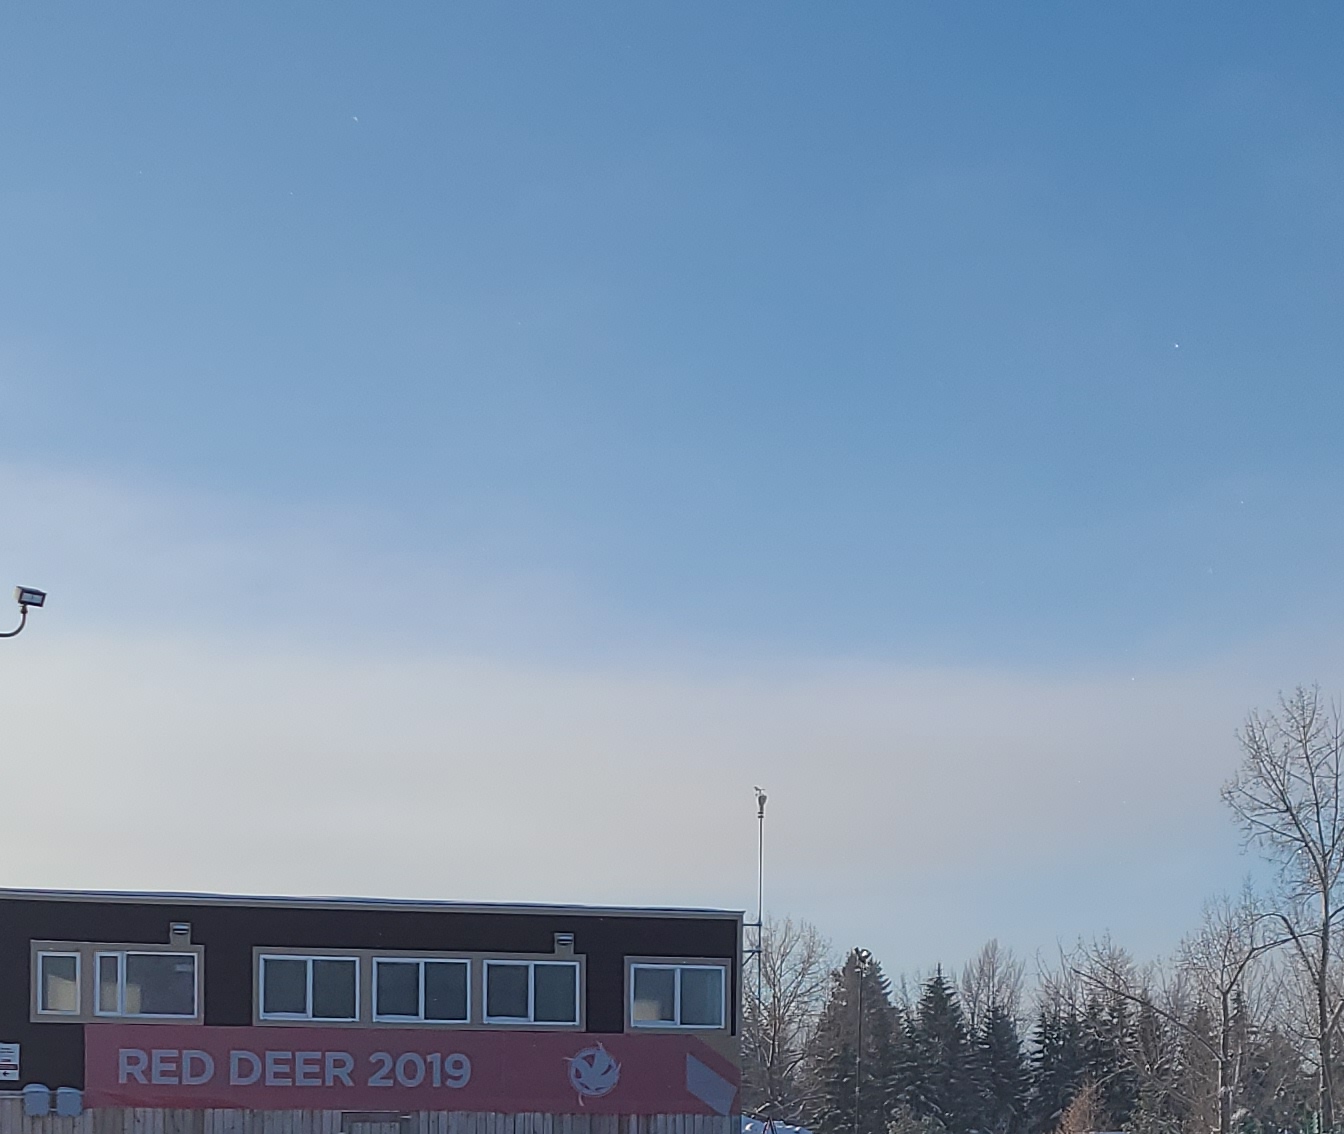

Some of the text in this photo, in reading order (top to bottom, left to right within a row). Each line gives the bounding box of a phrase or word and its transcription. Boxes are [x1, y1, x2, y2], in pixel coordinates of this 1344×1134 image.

[118, 1048, 472, 1089] RED DEER 2019
